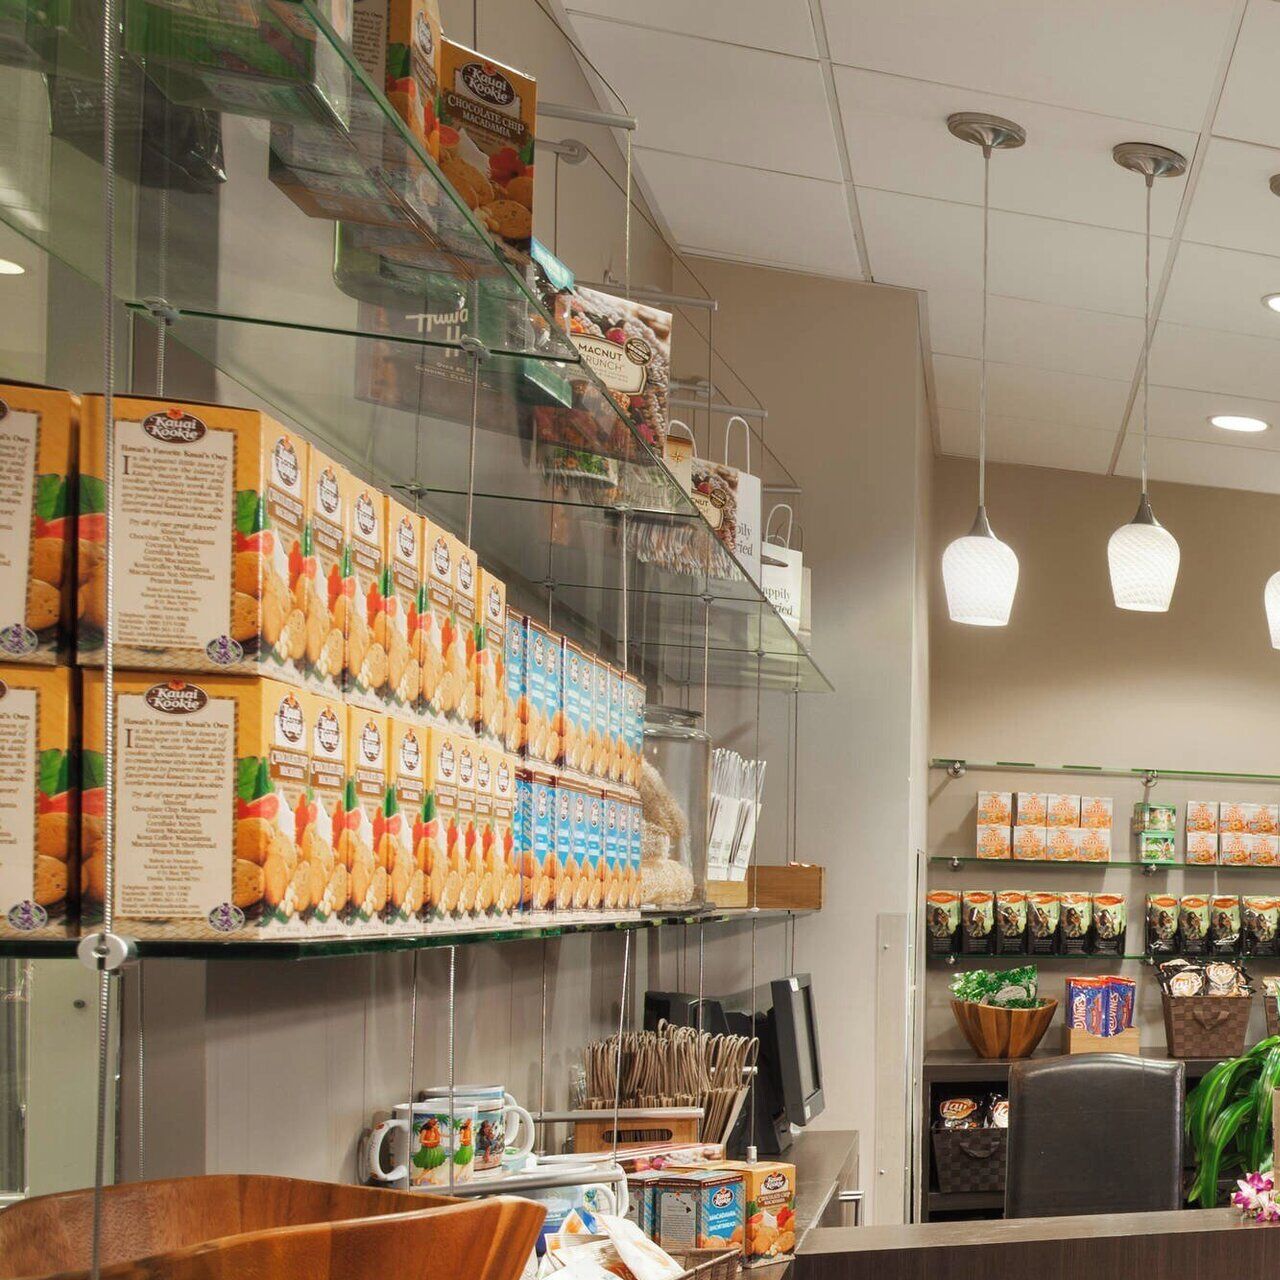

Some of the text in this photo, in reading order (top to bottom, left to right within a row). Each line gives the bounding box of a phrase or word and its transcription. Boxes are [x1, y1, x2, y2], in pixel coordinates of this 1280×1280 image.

[447, 94, 525, 135] CHOCOLATE CHIP
[462, 111, 511, 137] MACADAMIA
[578, 344, 623, 360] MACNUT
[150, 415, 197, 429] Kauai
[146, 426, 198, 442] Kookie
[152, 688, 198, 700] Kauai
[148, 697, 200, 711] Kookie
